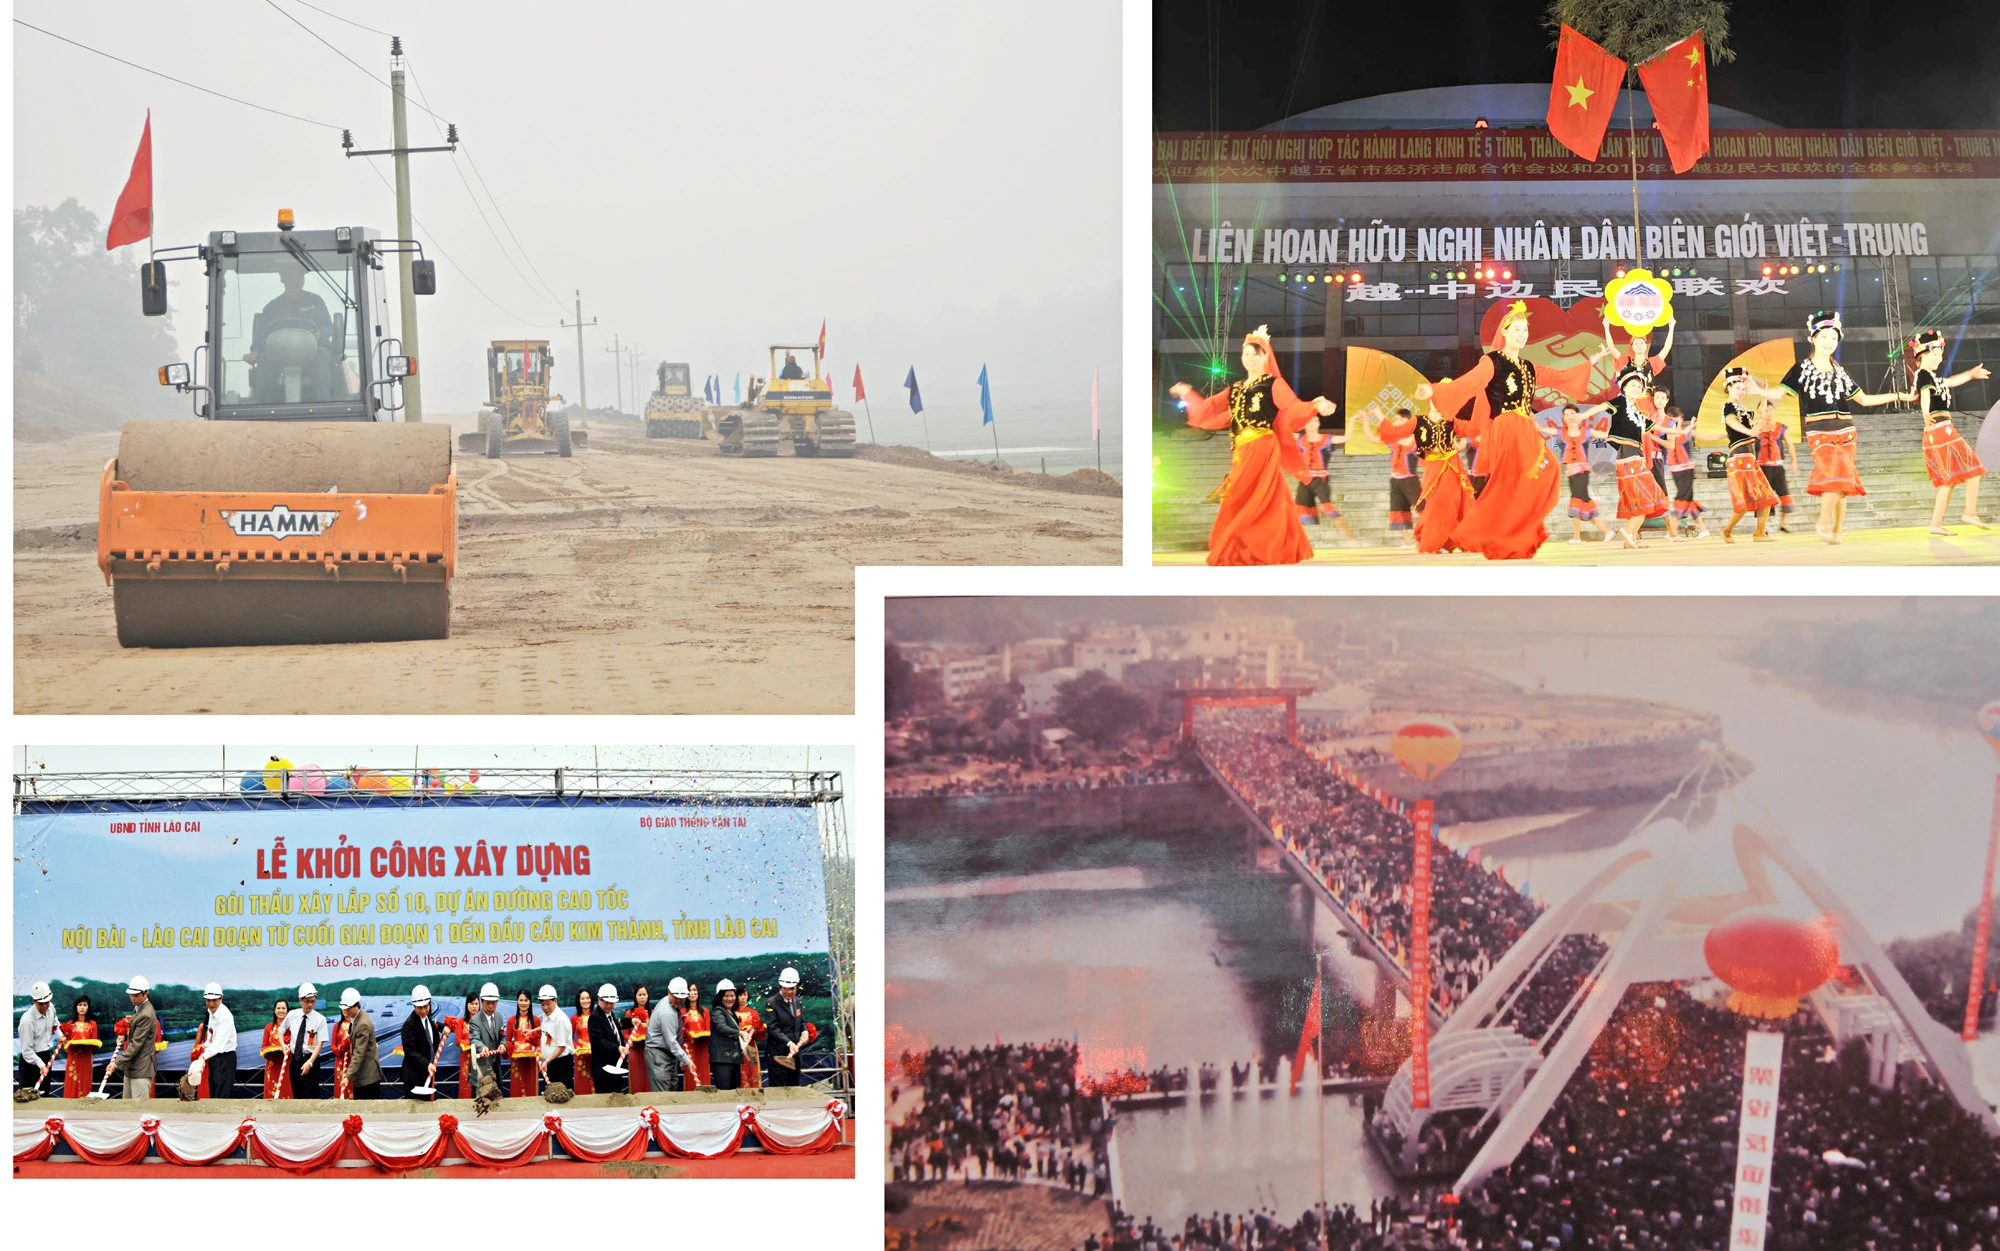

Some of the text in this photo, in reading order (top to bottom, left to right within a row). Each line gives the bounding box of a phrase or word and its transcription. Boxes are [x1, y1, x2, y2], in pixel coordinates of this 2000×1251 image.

[1181, 131, 1210, 161] BIỂU
[1231, 136, 1250, 165] DỰ
[1252, 134, 1272, 164] HỘI
[1275, 138, 1305, 164] NGHỊ
[1308, 137, 1334, 164] HỢP
[1337, 133, 1360, 160] TÁC
[1363, 133, 1397, 160] HÀNH
[1400, 136, 1432, 160] LANG
[1435, 136, 1465, 159] KINH
[1467, 131, 1483, 159] TẾ
[1485, 136, 1492, 159] 5
[1626, 131, 1650, 158] THỨ
[1651, 136, 1664, 158] VI
[1713, 136, 1745, 158] HOAN
[1748, 132, 1772, 158] HỮU
[1774, 136, 1803, 161] NGHỊ
[1805, 132, 1838, 158] NHÂN
[1840, 132, 1864, 158] DÂN
[1866, 132, 1893, 158] BIÊN
[1895, 131, 1918, 158] GIỚI
[1919, 132, 1944, 161] VIỆT
[1953, 136, 1991, 158] TRUNG
[1192, 219, 1254, 263] LIÊN
[1263, 228, 1339, 264] HOAN
[1347, 217, 1408, 263] HỮU
[1417, 226, 1484, 269] NGHỊ
[1494, 219, 1571, 261] NHÂN
[1581, 217, 1636, 260] DÂN
[1646, 217, 1707, 259] BIÊN
[1715, 213, 1766, 259] GIỚI
[240, 513, 320, 533] HAMM
[109, 818, 201, 834] UBND TỈNH LÀO CAI
[639, 814, 653, 830] BỘ
[655, 816, 677, 828] GIAO
[711, 815, 731, 830] VẬN
[256, 834, 591, 882] LỄ KHỞI CÔNG XÂY DỰNG
[214, 882, 629, 916] GÓI THẦU XÂY LẮP SỐ 10, DỰ ÁN ĐƯỜNG CAO TỐC
[61, 923, 92, 954] NỘI
[97, 924, 126, 948] BÀI
[142, 923, 175, 948] LÀO
[180, 927, 209, 948] CAI
[213, 927, 262, 952] ĐOẠN
[267, 921, 291, 946] TỪ
[294, 918, 335, 946] CUỐI
[339, 925, 376, 945] GIAI
[380, 923, 428, 949] ĐOẠN
[434, 923, 443, 943] 1
[448, 916, 485, 943] ĐẾN
[489, 916, 525, 943] ĐẦU
[529, 915, 565, 942] CẦU
[569, 921, 602, 941] KIM
[608, 917, 669, 943] THÀNH,
[672, 911, 711, 940] TỈNH
[714, 915, 746, 939] LÀO
[750, 918, 778, 938] CAI
[316, 952, 534, 972] Lào Cai, ngày 24 tháng 4 năm 2010
